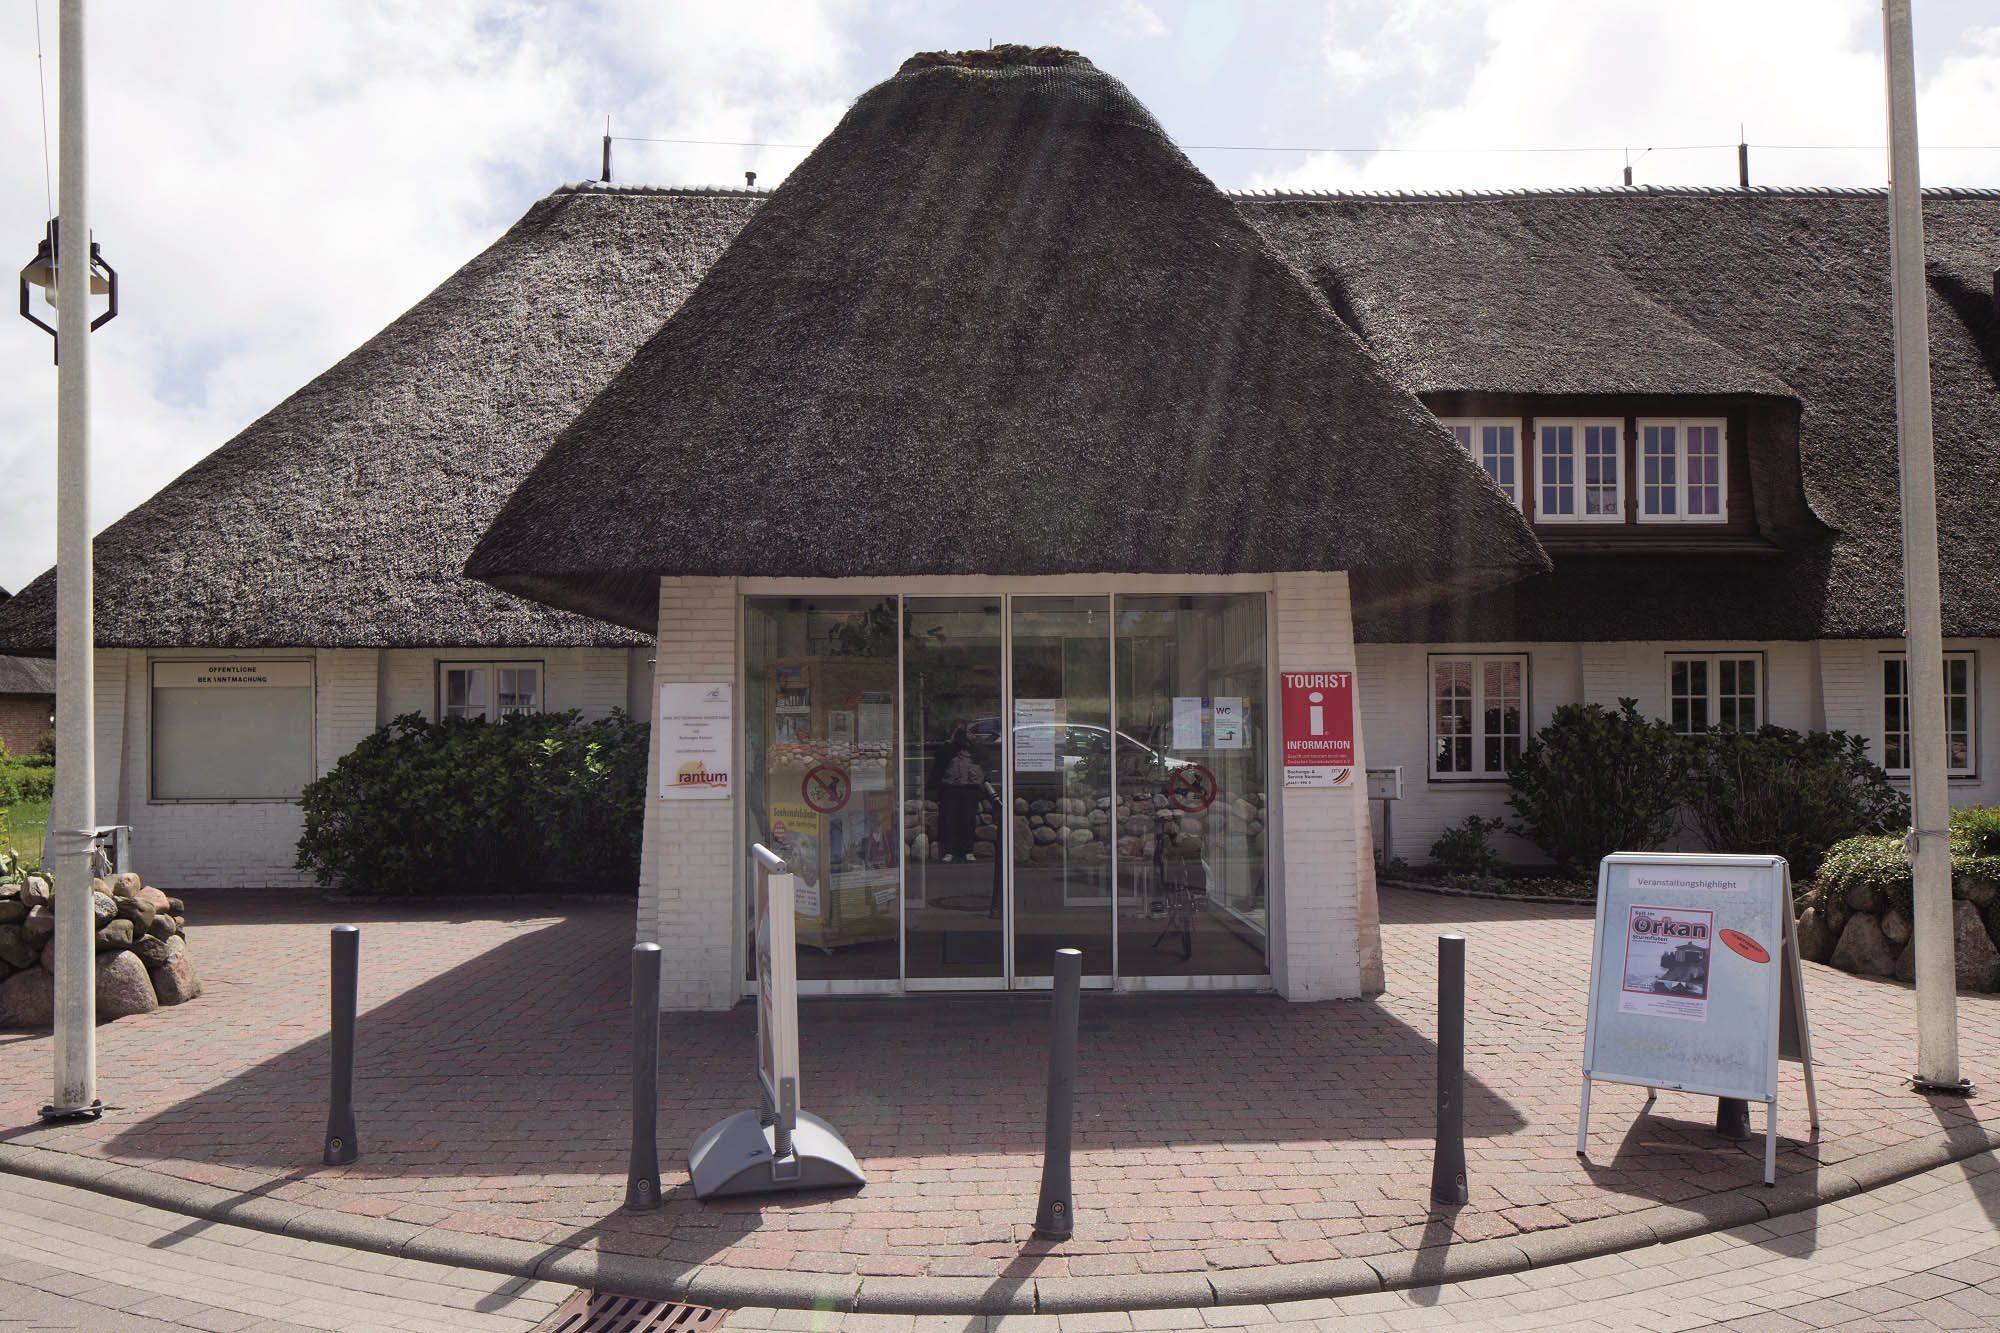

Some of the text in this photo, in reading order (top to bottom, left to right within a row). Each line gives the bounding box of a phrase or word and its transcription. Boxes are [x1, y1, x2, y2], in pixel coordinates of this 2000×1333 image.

[1285, 674, 1348, 689] TOURIST
[1216, 707, 1231, 715] WC
[1287, 740, 1350, 750] INFORMATION
[679, 770, 728, 783] rantum
[1638, 878, 1737, 890] Veranstaltungshighlight
[1633, 917, 1708, 939] Orkan
